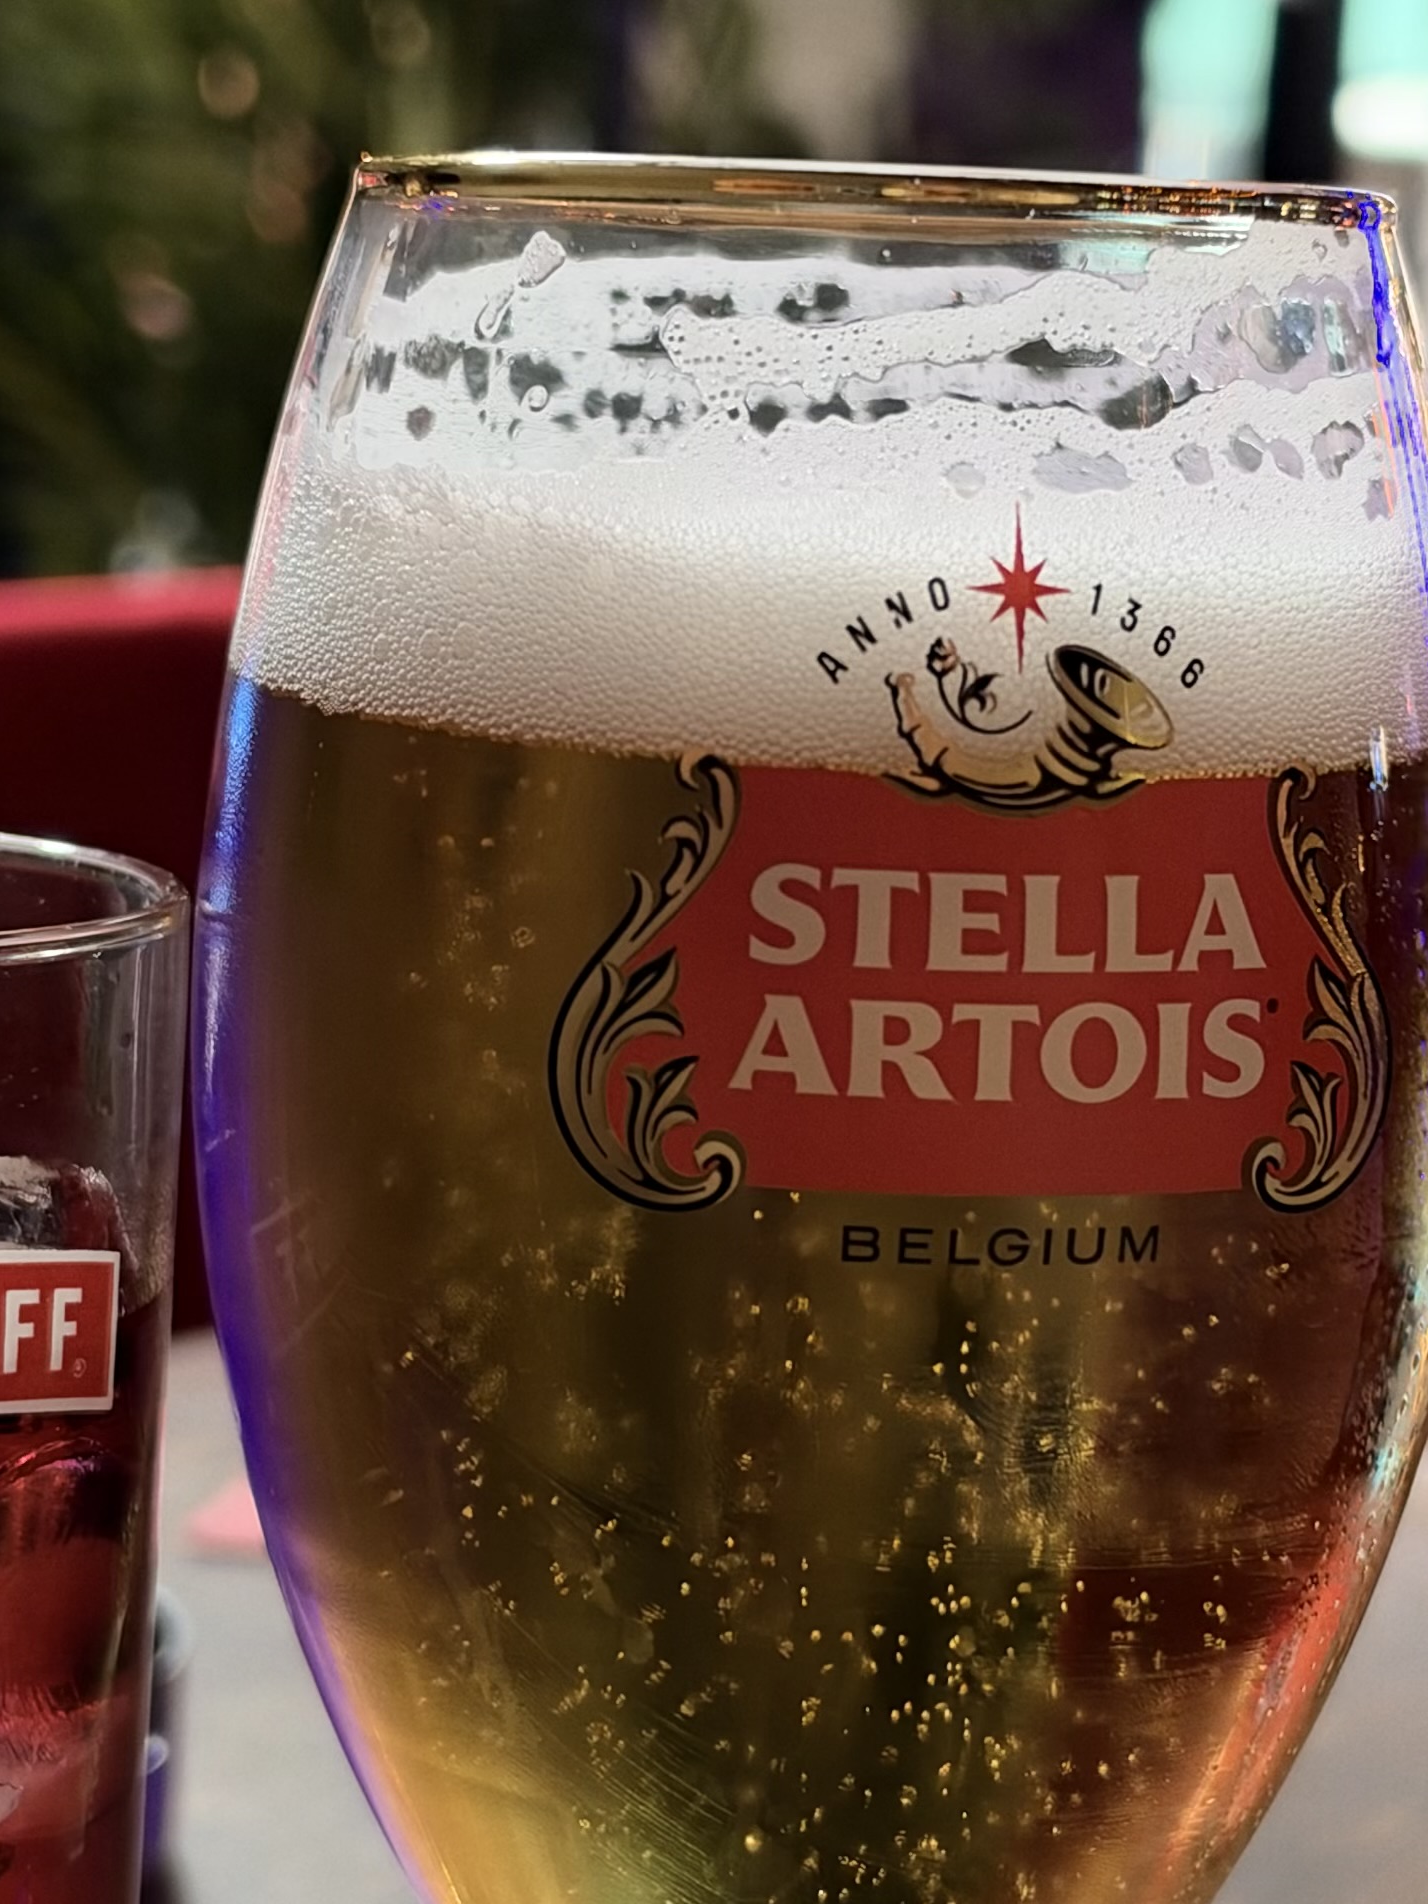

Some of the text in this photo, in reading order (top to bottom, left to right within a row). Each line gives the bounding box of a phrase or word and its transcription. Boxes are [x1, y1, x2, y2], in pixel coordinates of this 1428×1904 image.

[815, 576, 1205, 689] ANNO 1366
[745, 862, 1268, 974] STELLA
[727, 993, 1266, 1103] ARTOIS
[840, 1224, 1160, 1267] BELGIUM
